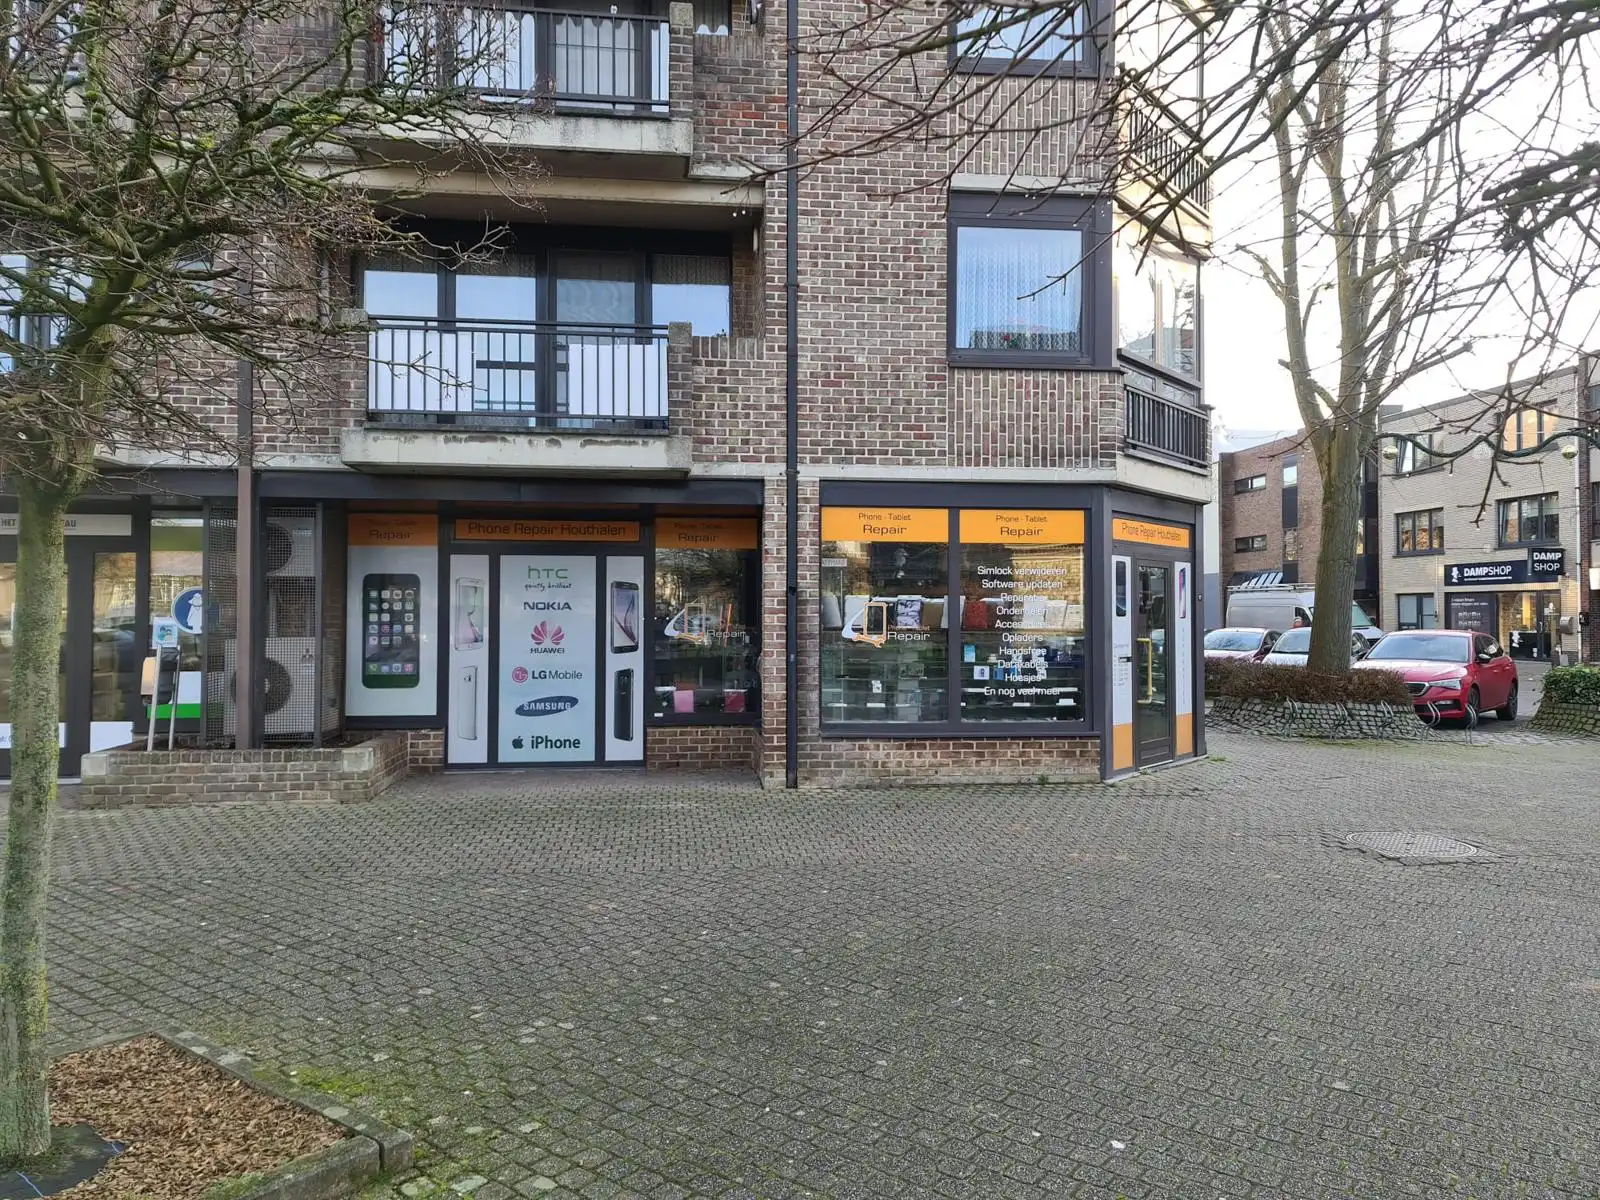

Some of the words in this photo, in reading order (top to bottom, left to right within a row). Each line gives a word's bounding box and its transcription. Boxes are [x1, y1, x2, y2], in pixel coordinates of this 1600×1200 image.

[858, 512, 882, 521] Phone
[888, 512, 911, 521] Tablet
[995, 514, 1020, 523] Phone
[1025, 514, 1048, 523] Tablet
[468, 521, 510, 535] Phone
[513, 522, 557, 537] Repair
[561, 523, 626, 537] Houthalen
[863, 524, 907, 536] Repair
[1000, 526, 1044, 538] Repair
[678, 532, 719, 544] Repair
[1533, 552, 1562, 561] DAMP
[977, 565, 1013, 576] Simlock
[1463, 565, 1512, 577] DAMPSHOP
[1534, 562, 1561, 572] SHOP
[982, 579, 1024, 589] Software
[1026, 580, 1063, 590] updaten
[523, 602, 572, 611] NOKIA
[706, 629, 746, 640] Repair
[888, 631, 931, 643] Repair
[1002, 632, 1044, 643] Opladers
[999, 646, 1047, 656] Handsfree
[997, 659, 1049, 669] Datakabels
[532, 670, 547, 680] LG
[548, 670, 583, 680] Mobile
[1005, 673, 1042, 684] Hoesjes
[984, 686, 996, 696] En
[998, 688, 1016, 697] nog
[1017, 686, 1037, 696] veel
[523, 702, 572, 711] SAMSUNG
[530, 735, 581, 749] iPhone
